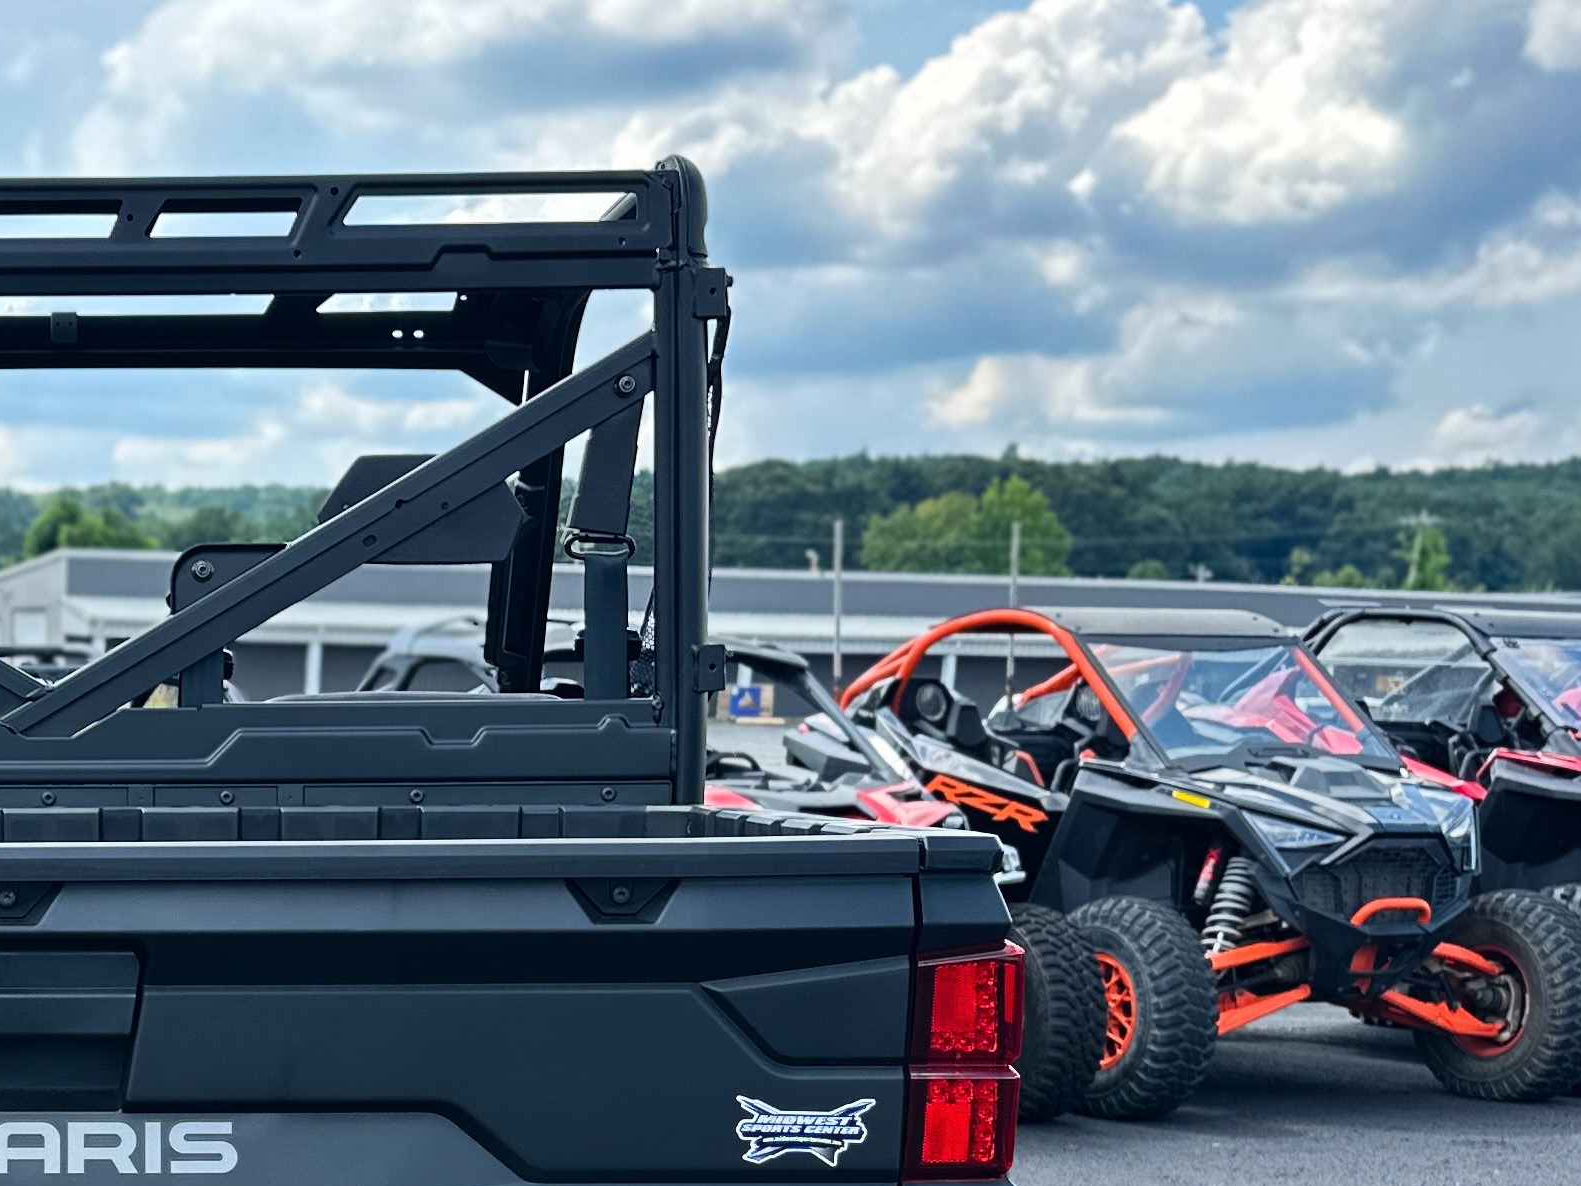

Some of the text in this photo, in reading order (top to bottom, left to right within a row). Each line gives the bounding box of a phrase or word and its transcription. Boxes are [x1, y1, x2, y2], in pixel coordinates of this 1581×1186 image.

[924, 773, 1048, 833] RZR
[755, 1114, 852, 1126] MIDWEST
[740, 1123, 861, 1135] SPORTS CENTER
